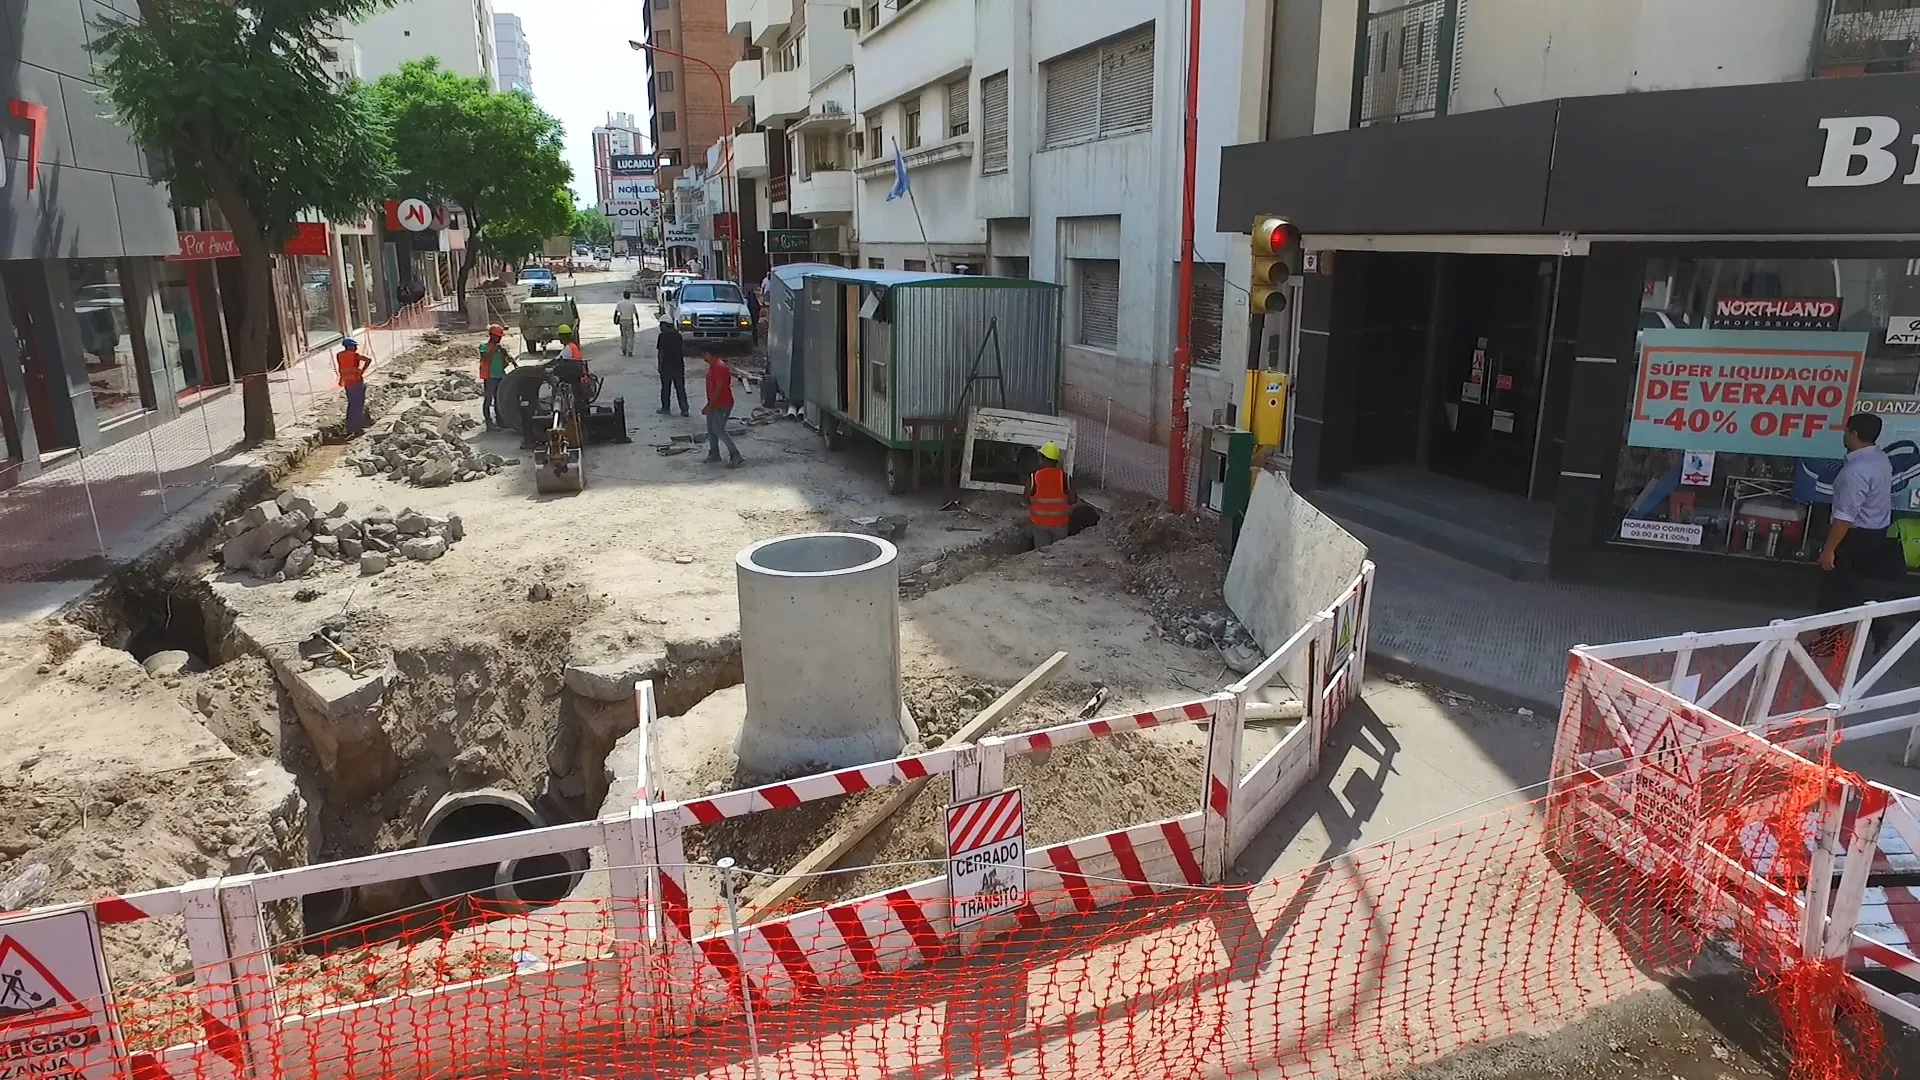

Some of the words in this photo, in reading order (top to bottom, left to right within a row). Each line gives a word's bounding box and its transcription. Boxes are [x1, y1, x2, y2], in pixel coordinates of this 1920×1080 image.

[617, 159, 656, 169] LUCAIOLI
[618, 185, 657, 193] NOBLEX
[604, 201, 650, 216] Look
[1716, 301, 1836, 318] NORTHLAND
[1713, 320, 1832, 328] PROFESSIONAL
[1649, 361, 1713, 378] SÚPER
[1718, 365, 1848, 382] LIQUIDACIÓN
[1646, 379, 1691, 402] DE
[1699, 381, 1843, 408] VERANO
[1653, 407, 1738, 434] -40%
[1750, 411, 1828, 438] OFF
[1623, 521, 1660, 530] HORARIO
[1661, 525, 1701, 535] CORRIDO
[956, 842, 1019, 877] CERRADO
